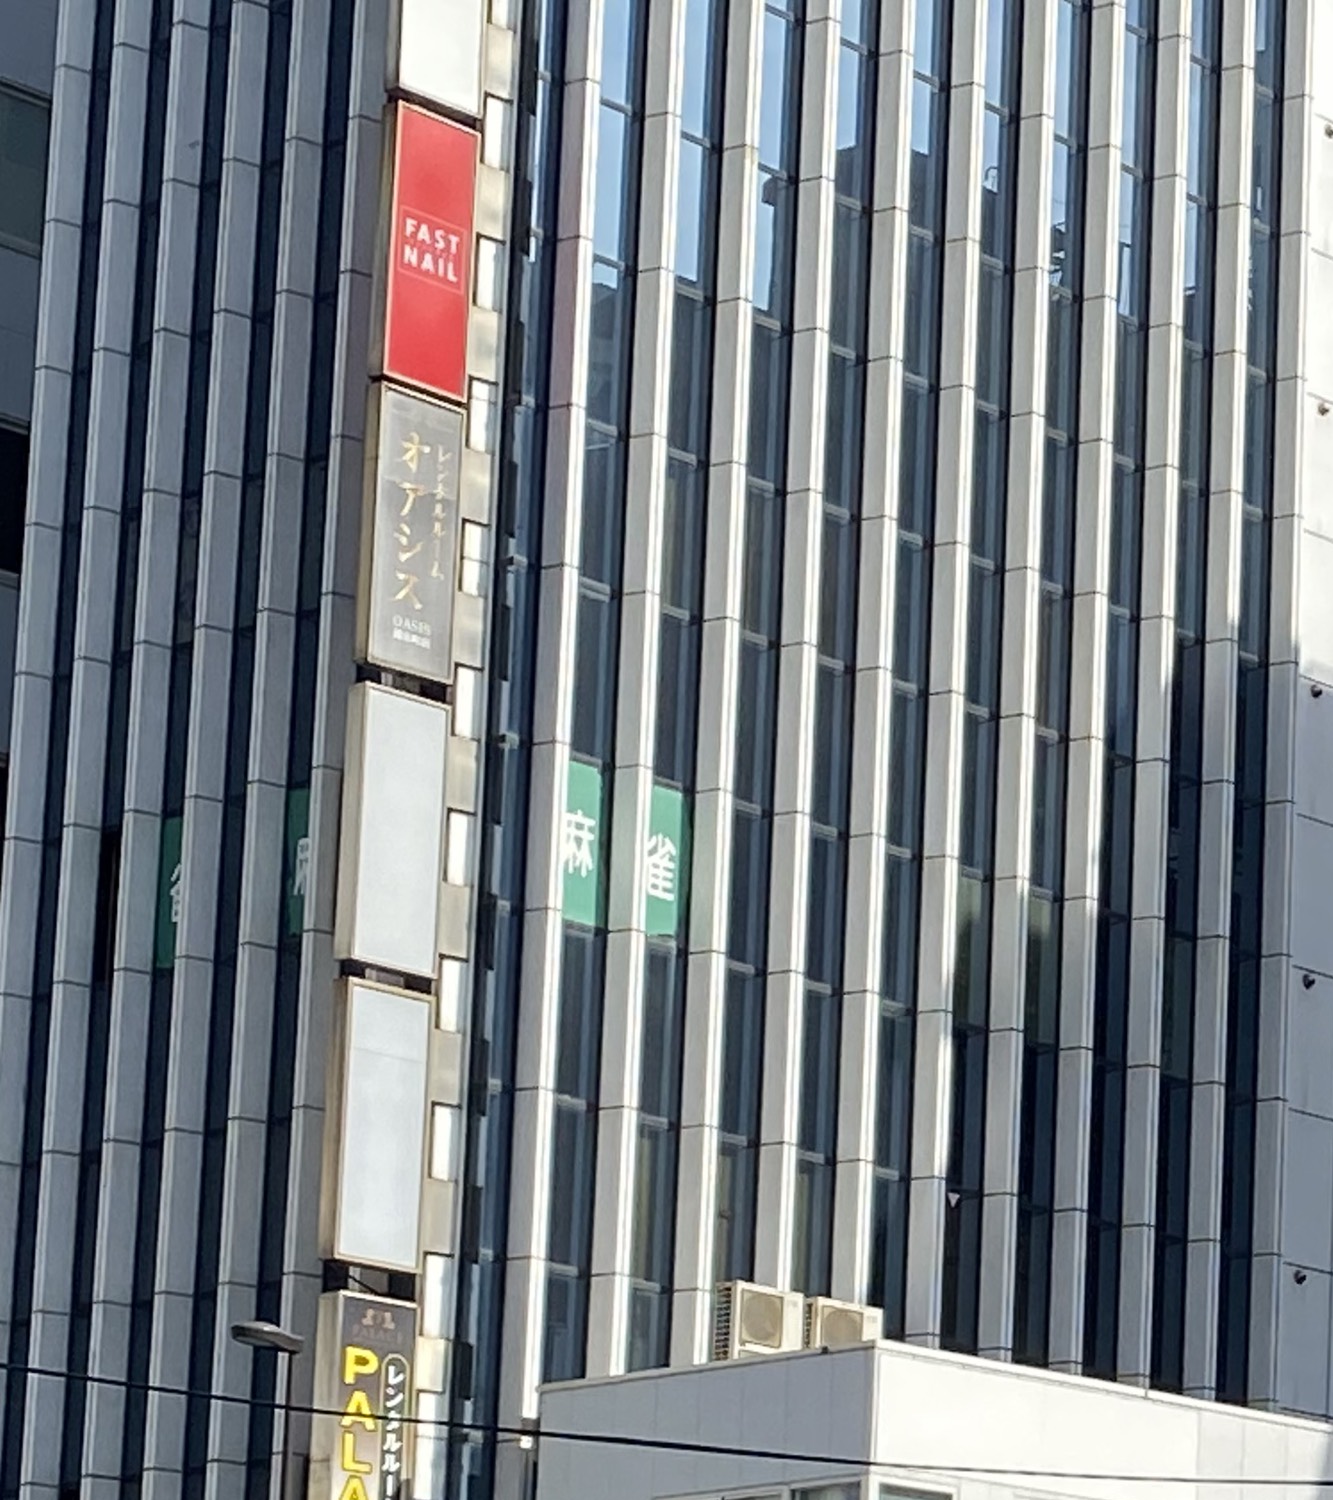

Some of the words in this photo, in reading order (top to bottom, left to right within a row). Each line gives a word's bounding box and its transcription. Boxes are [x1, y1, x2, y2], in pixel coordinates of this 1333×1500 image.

[404, 216, 461, 252] FAST
[402, 244, 458, 284] NAIL
[393, 432, 431, 611] オアシス
